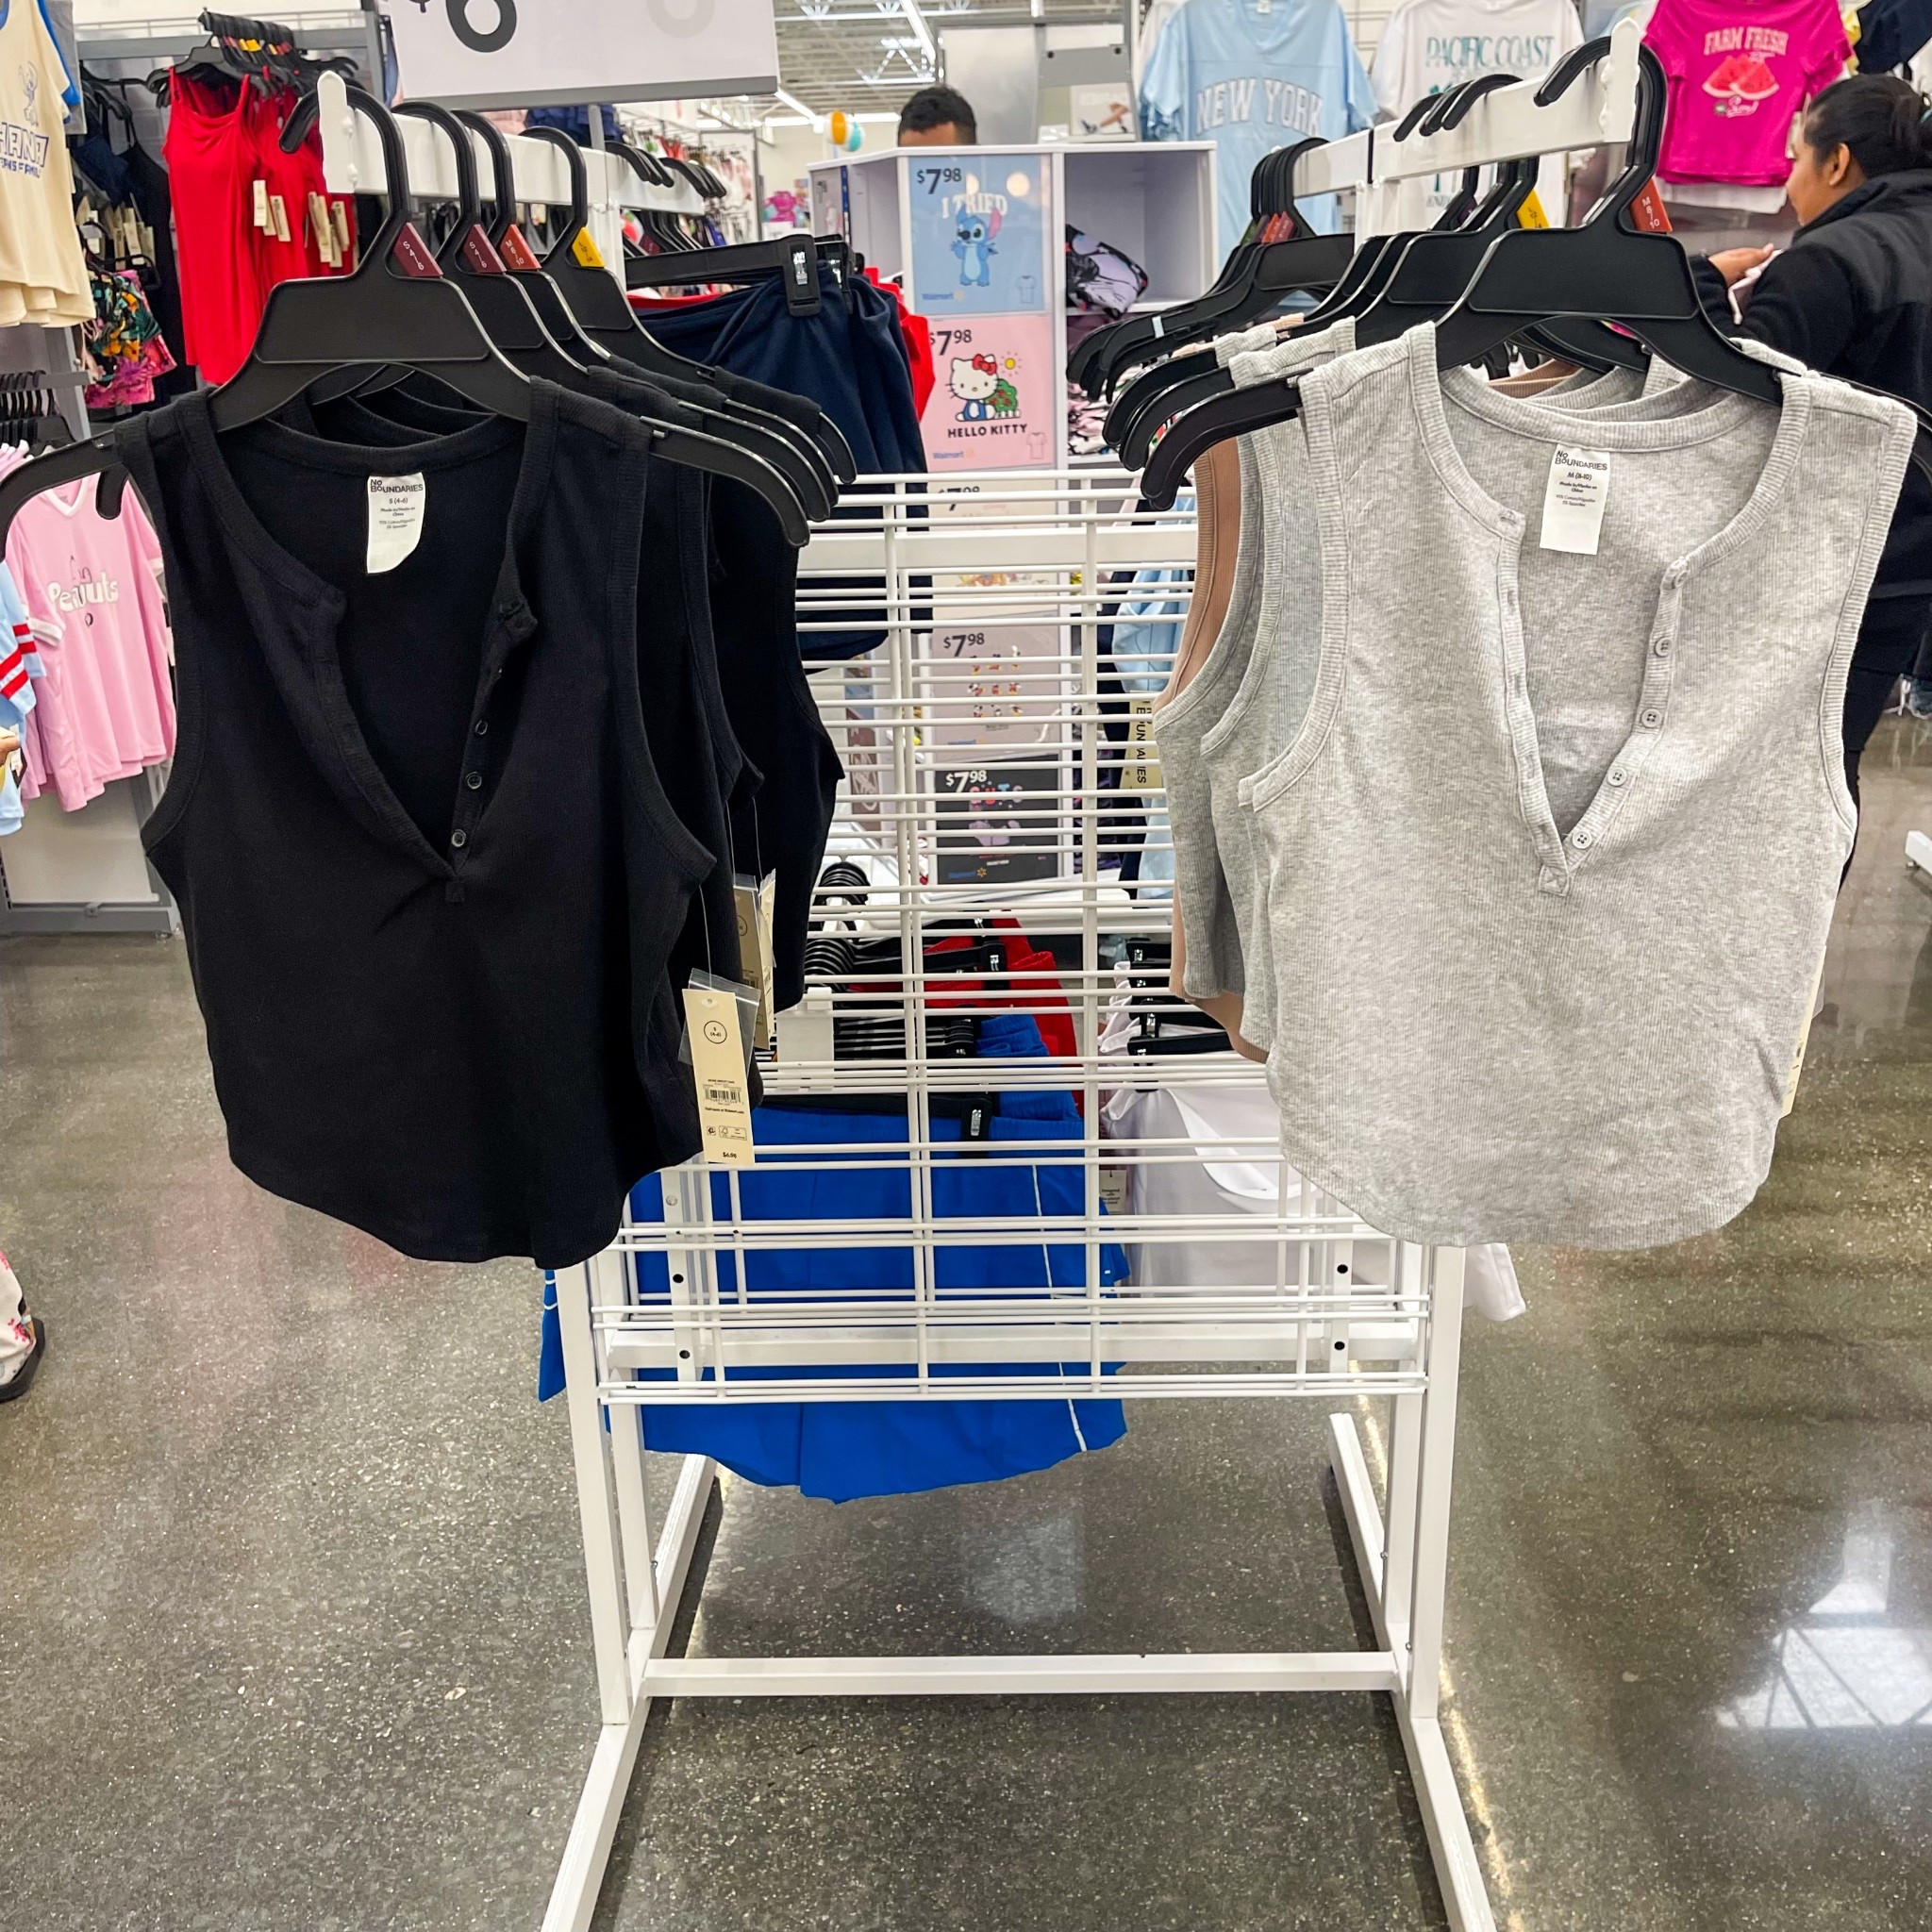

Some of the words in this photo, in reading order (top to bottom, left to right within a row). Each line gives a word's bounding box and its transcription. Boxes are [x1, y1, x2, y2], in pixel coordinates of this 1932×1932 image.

[1494, 35, 1555, 71] COAST
[1195, 76, 1256, 137] NEW
[1262, 77, 1323, 138] YORK
[941, 197, 949, 219] I
[952, 192, 1008, 217] TRIED
[947, 427, 987, 439] HELLO
[991, 424, 1027, 435] KITTY
[1555, 458, 1607, 471] BOUNDARIES
[370, 484, 424, 492] BOUNDARIES
[47, 571, 119, 612] Peanuts
